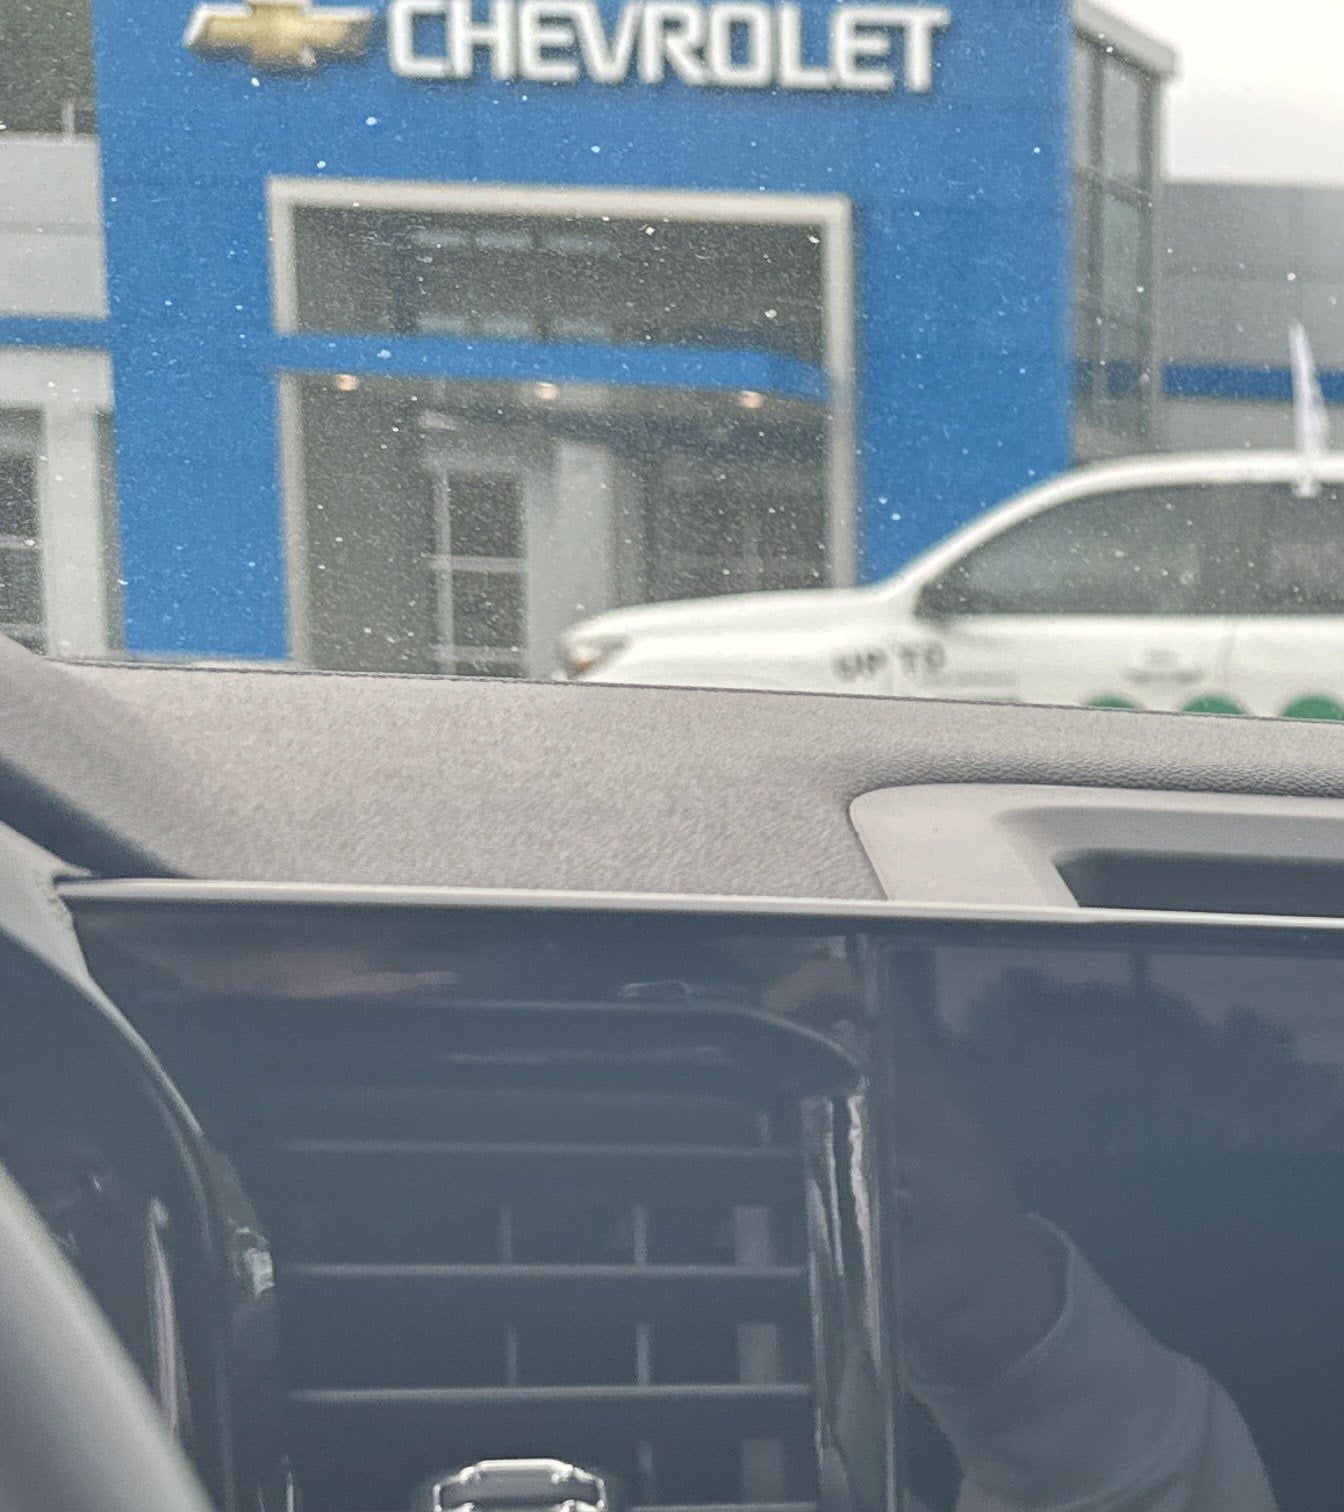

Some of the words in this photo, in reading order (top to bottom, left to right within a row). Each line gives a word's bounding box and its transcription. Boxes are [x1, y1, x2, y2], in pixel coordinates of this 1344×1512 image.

[387, 0, 950, 93] CHEVROLET
[832, 648, 889, 682] UP
[899, 640, 947, 676] TO
